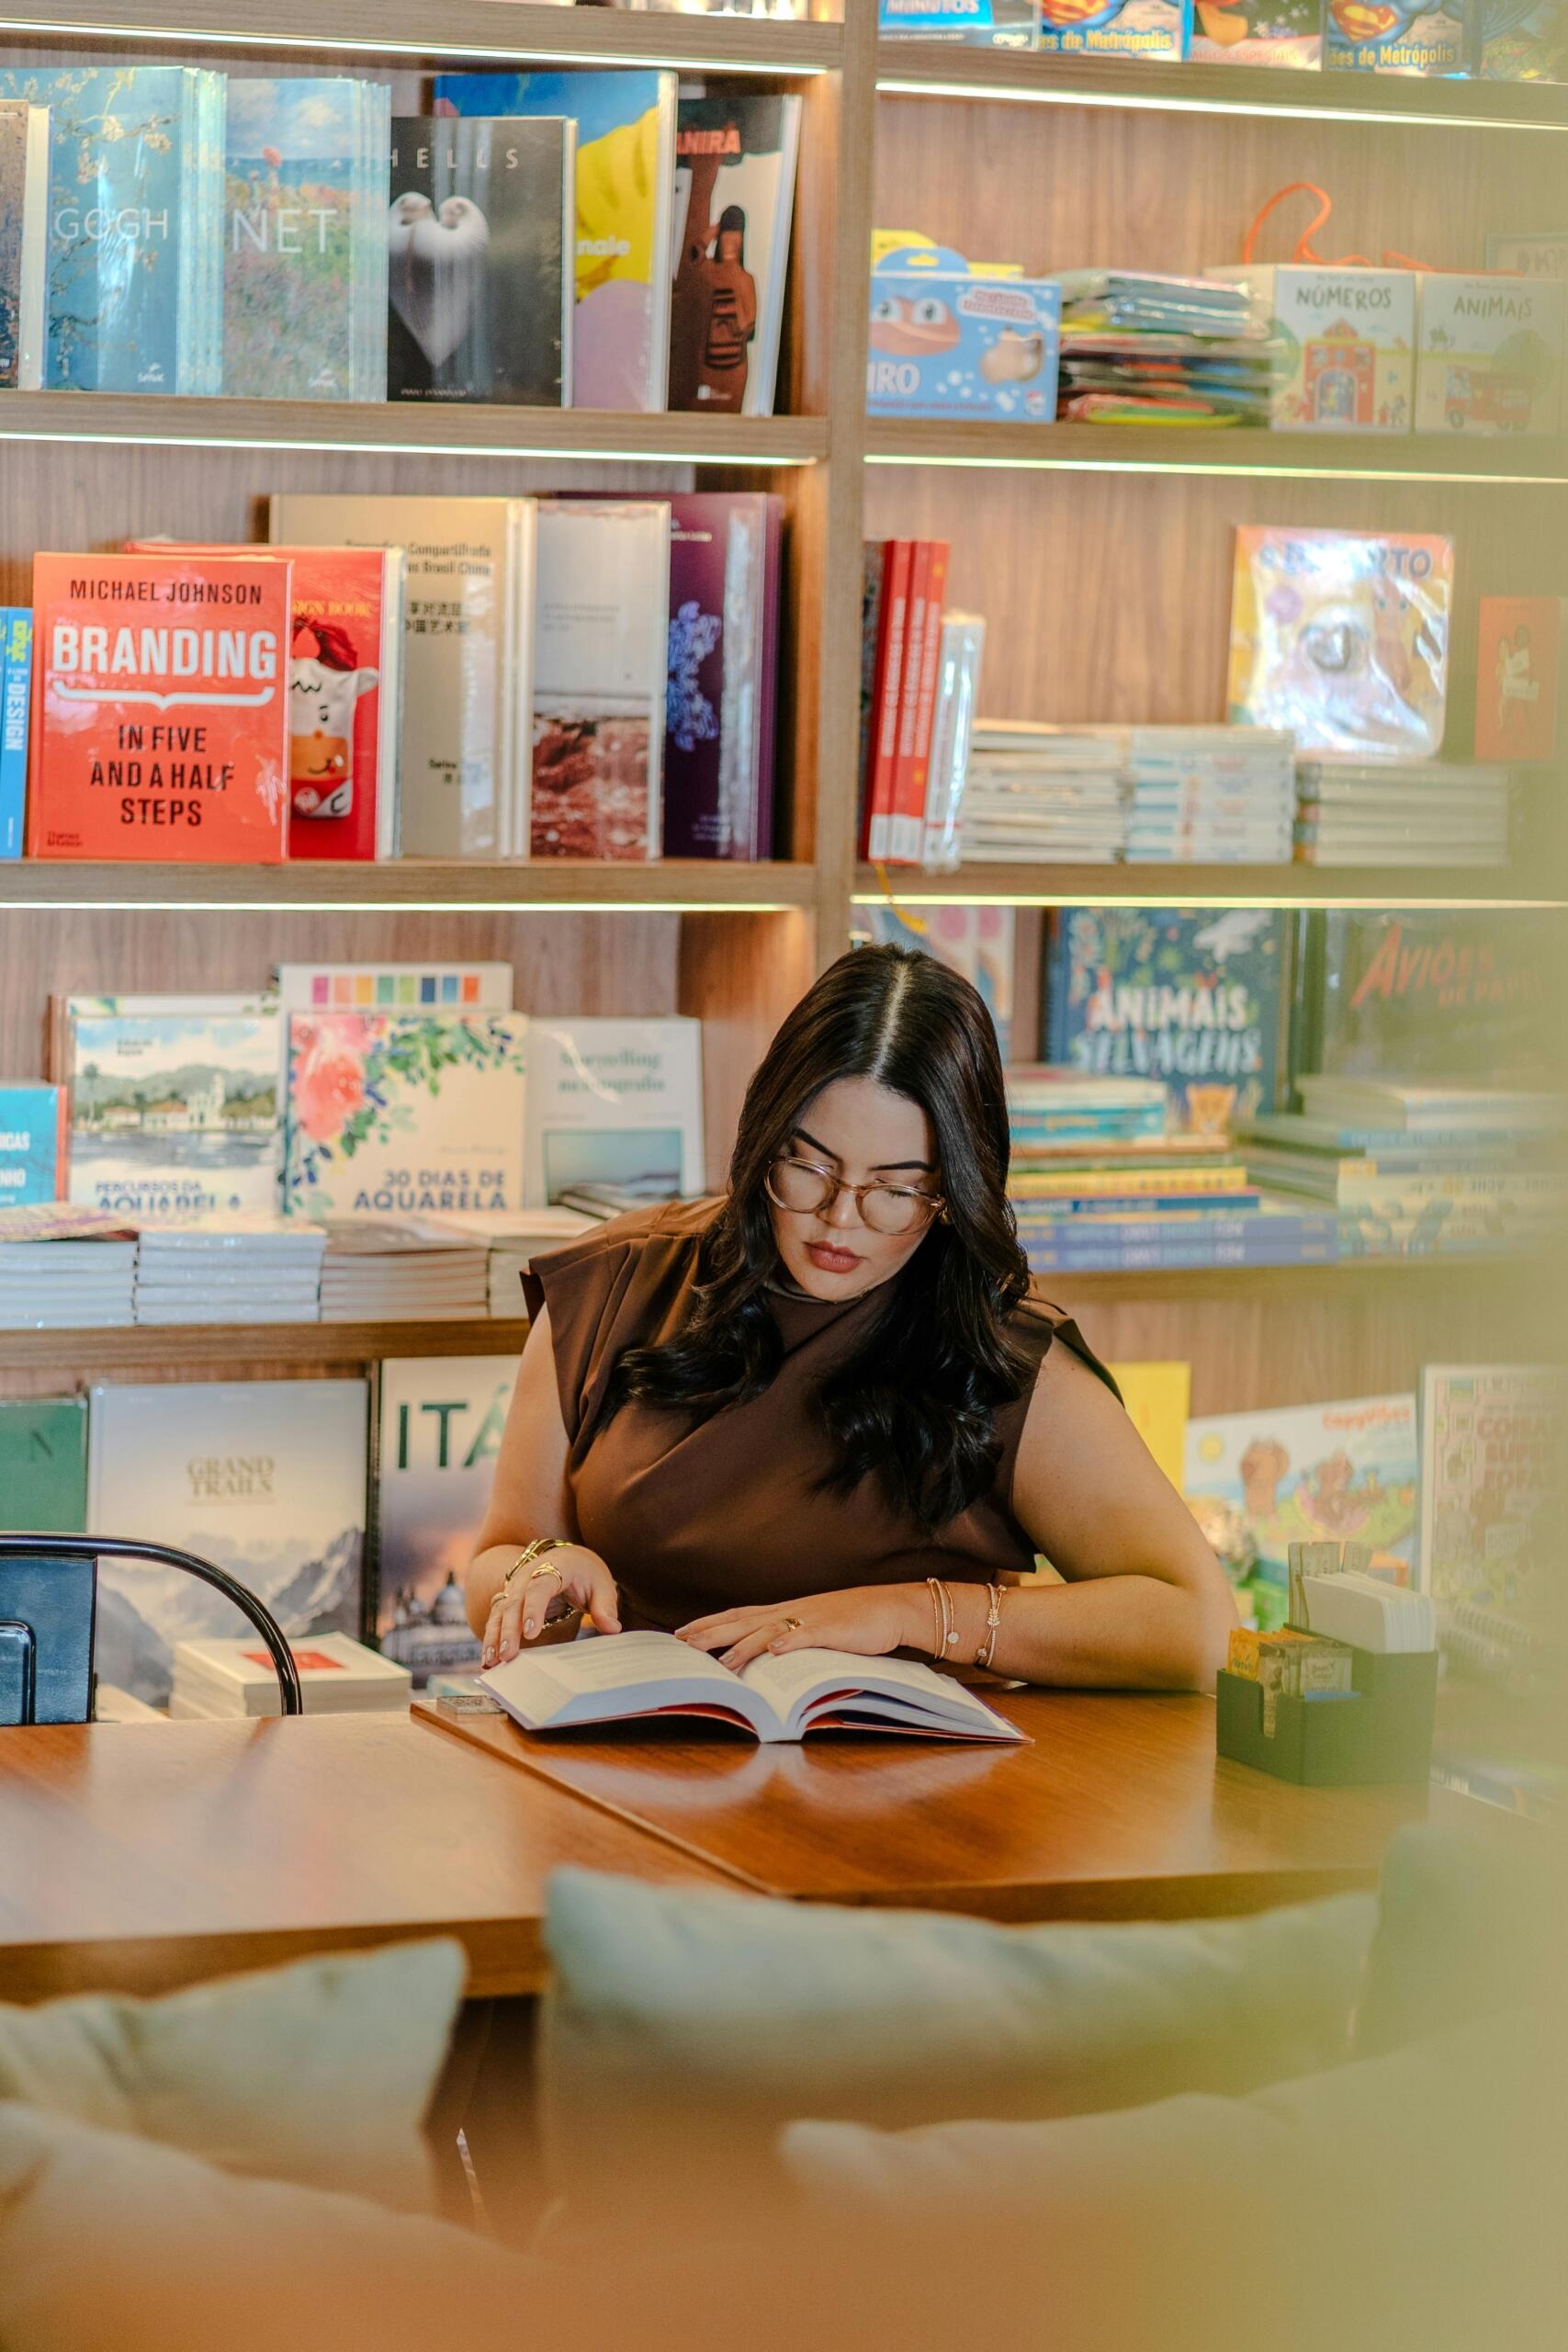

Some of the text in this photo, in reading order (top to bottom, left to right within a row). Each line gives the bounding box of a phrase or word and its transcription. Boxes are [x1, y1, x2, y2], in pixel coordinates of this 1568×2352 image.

[1380, 43, 1456, 70] Metrópolis
[53, 208, 169, 240] GOGH
[232, 209, 338, 254] NET
[1296, 283, 1392, 311] NÚMEROS
[1453, 294, 1533, 321] ANIMAIS
[70, 580, 262, 605] MICHAEL JOHNSON
[52, 625, 276, 679] BRANDING
[6, 683, 27, 751] DESIGN
[118, 725, 207, 752] IN FIVE
[90, 761, 233, 790] AND A HALF
[121, 797, 202, 826] STEPS
[1087, 985, 1249, 1032] ANIMAIS
[386, 1170, 504, 1187] 30 DIAS DE
[355, 1191, 507, 1212] AQUARELA
[187, 1456, 275, 1479] GRAND
